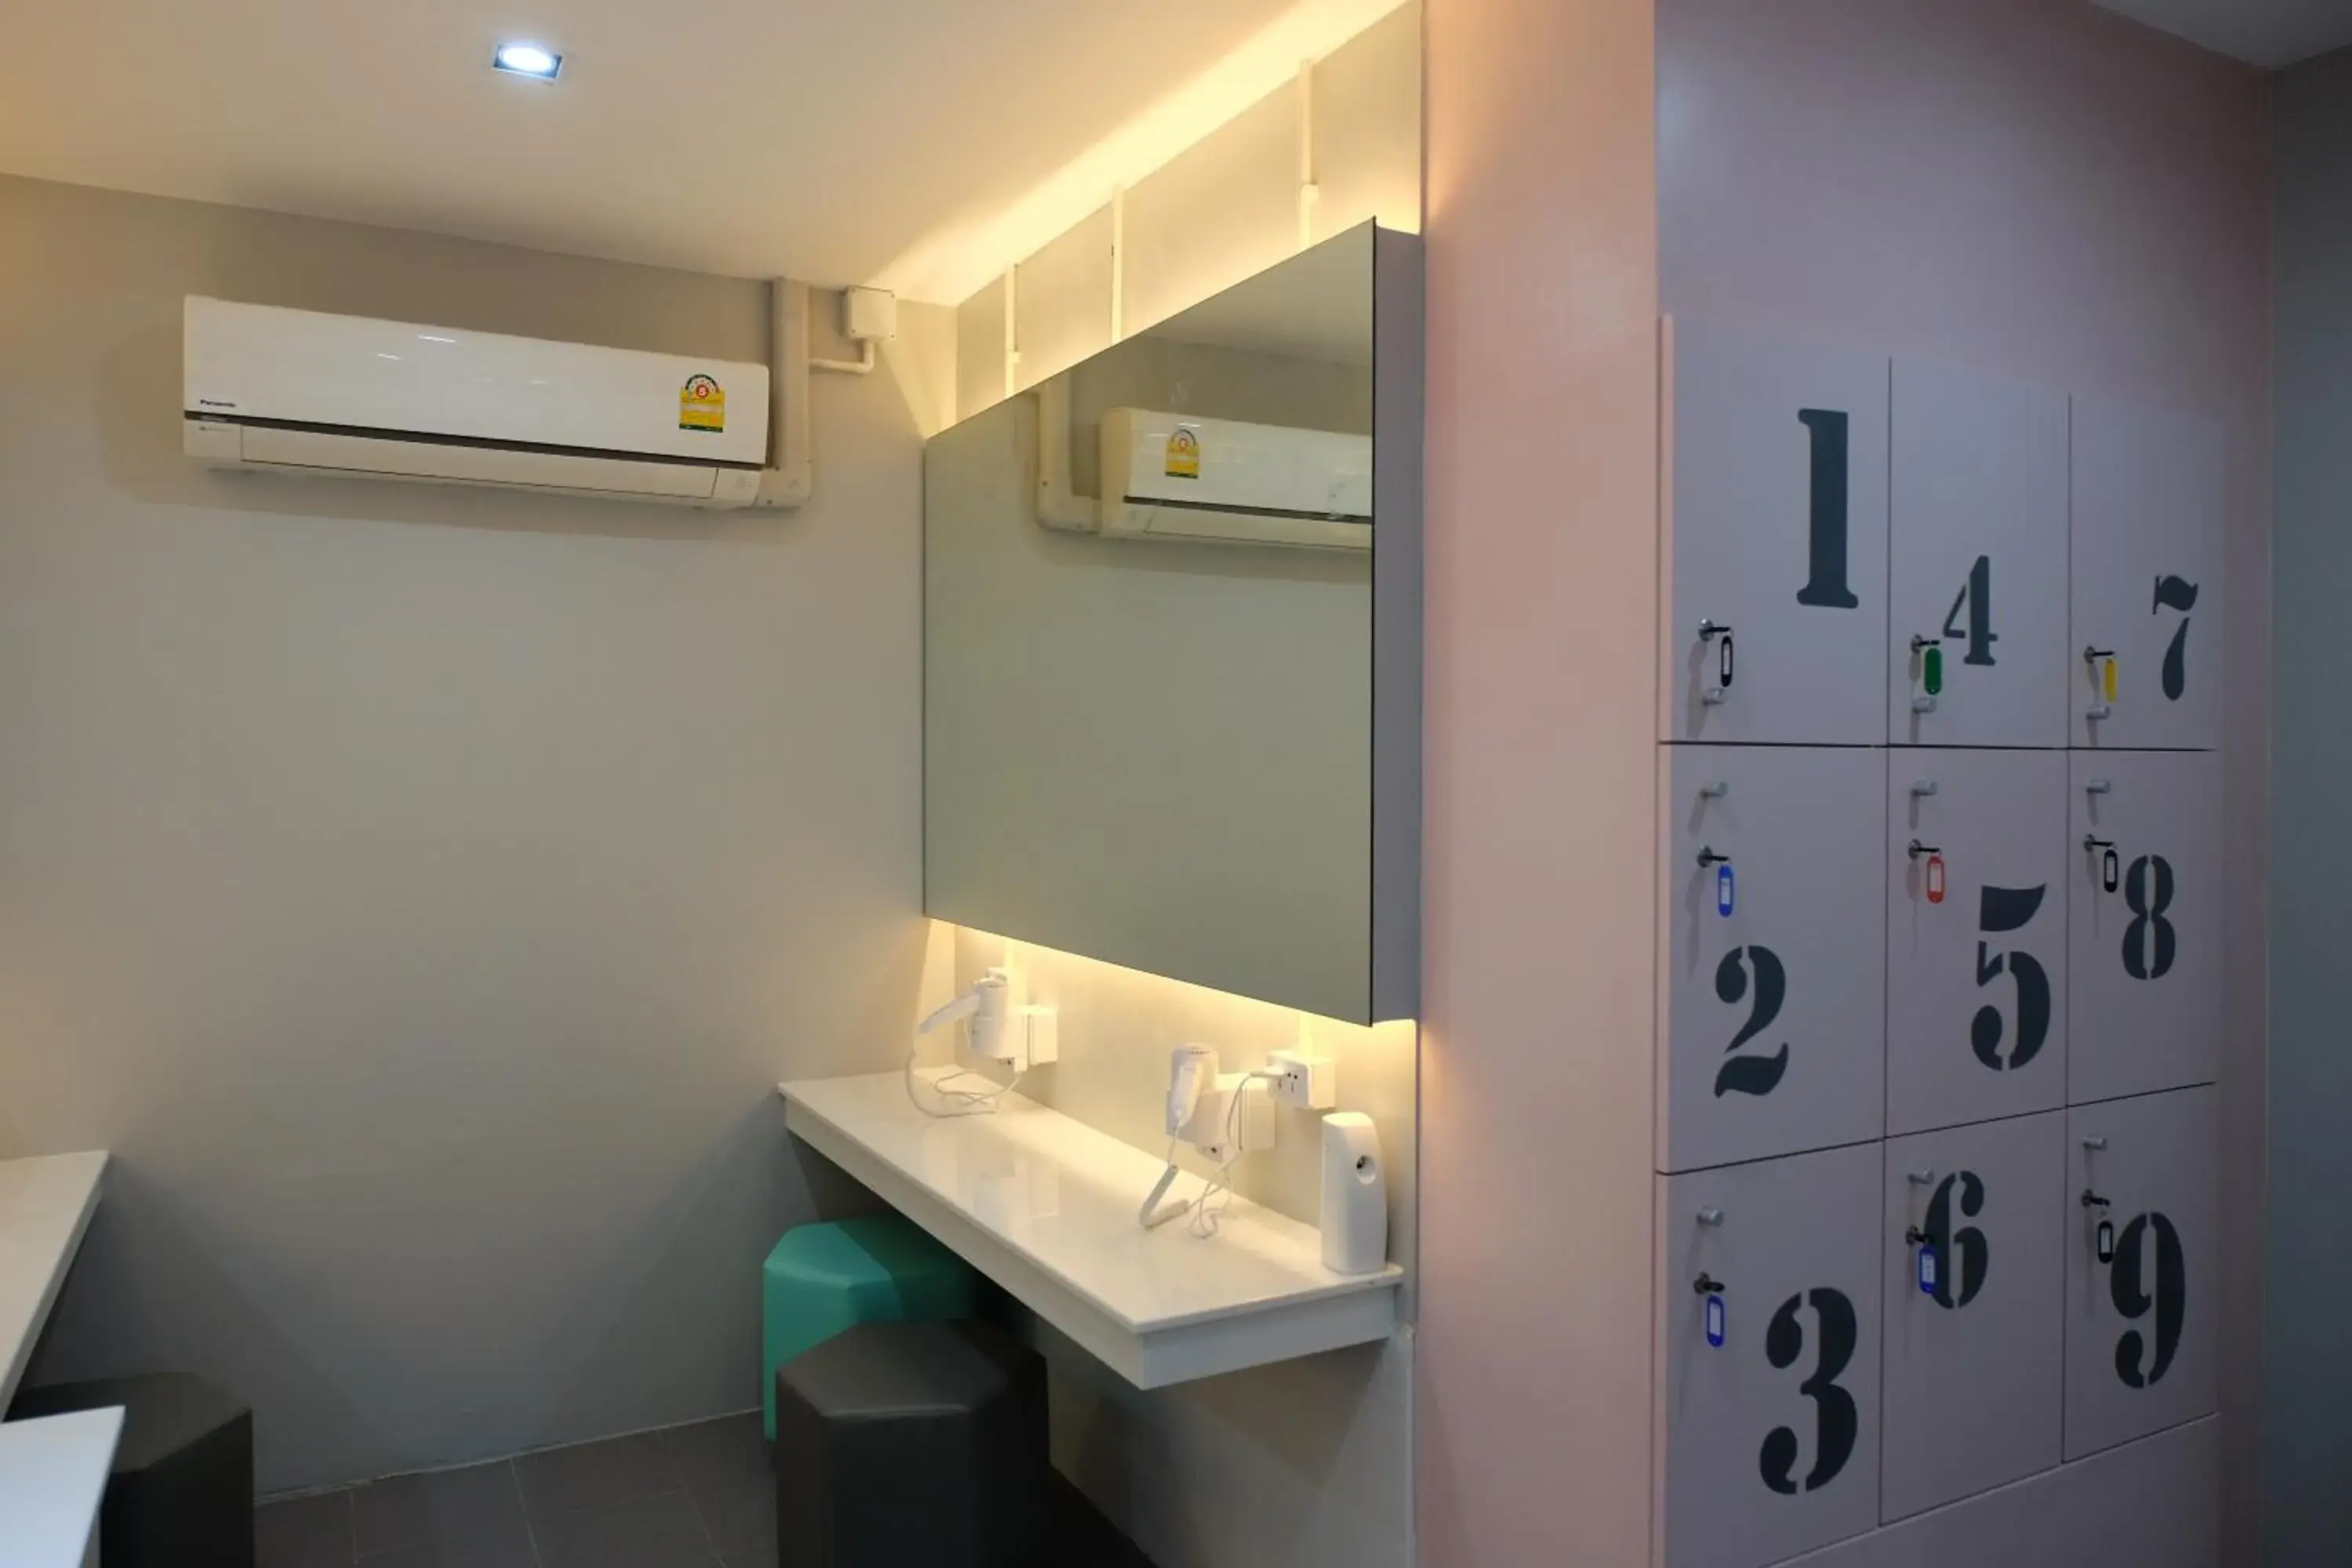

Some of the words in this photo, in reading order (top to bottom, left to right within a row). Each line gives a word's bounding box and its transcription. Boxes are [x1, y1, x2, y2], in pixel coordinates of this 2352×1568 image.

[1797, 408, 1858, 609] 1
[1943, 555, 1998, 666] 4
[2153, 575, 2198, 701] 7
[1971, 884, 2050, 1071] 5
[2122, 855, 2176, 980] 8
[1715, 945, 1788, 1098] 2
[1924, 1171, 1988, 1309] 6
[2111, 1212, 2185, 1389] 9
[1760, 1287, 1857, 1494] 3
